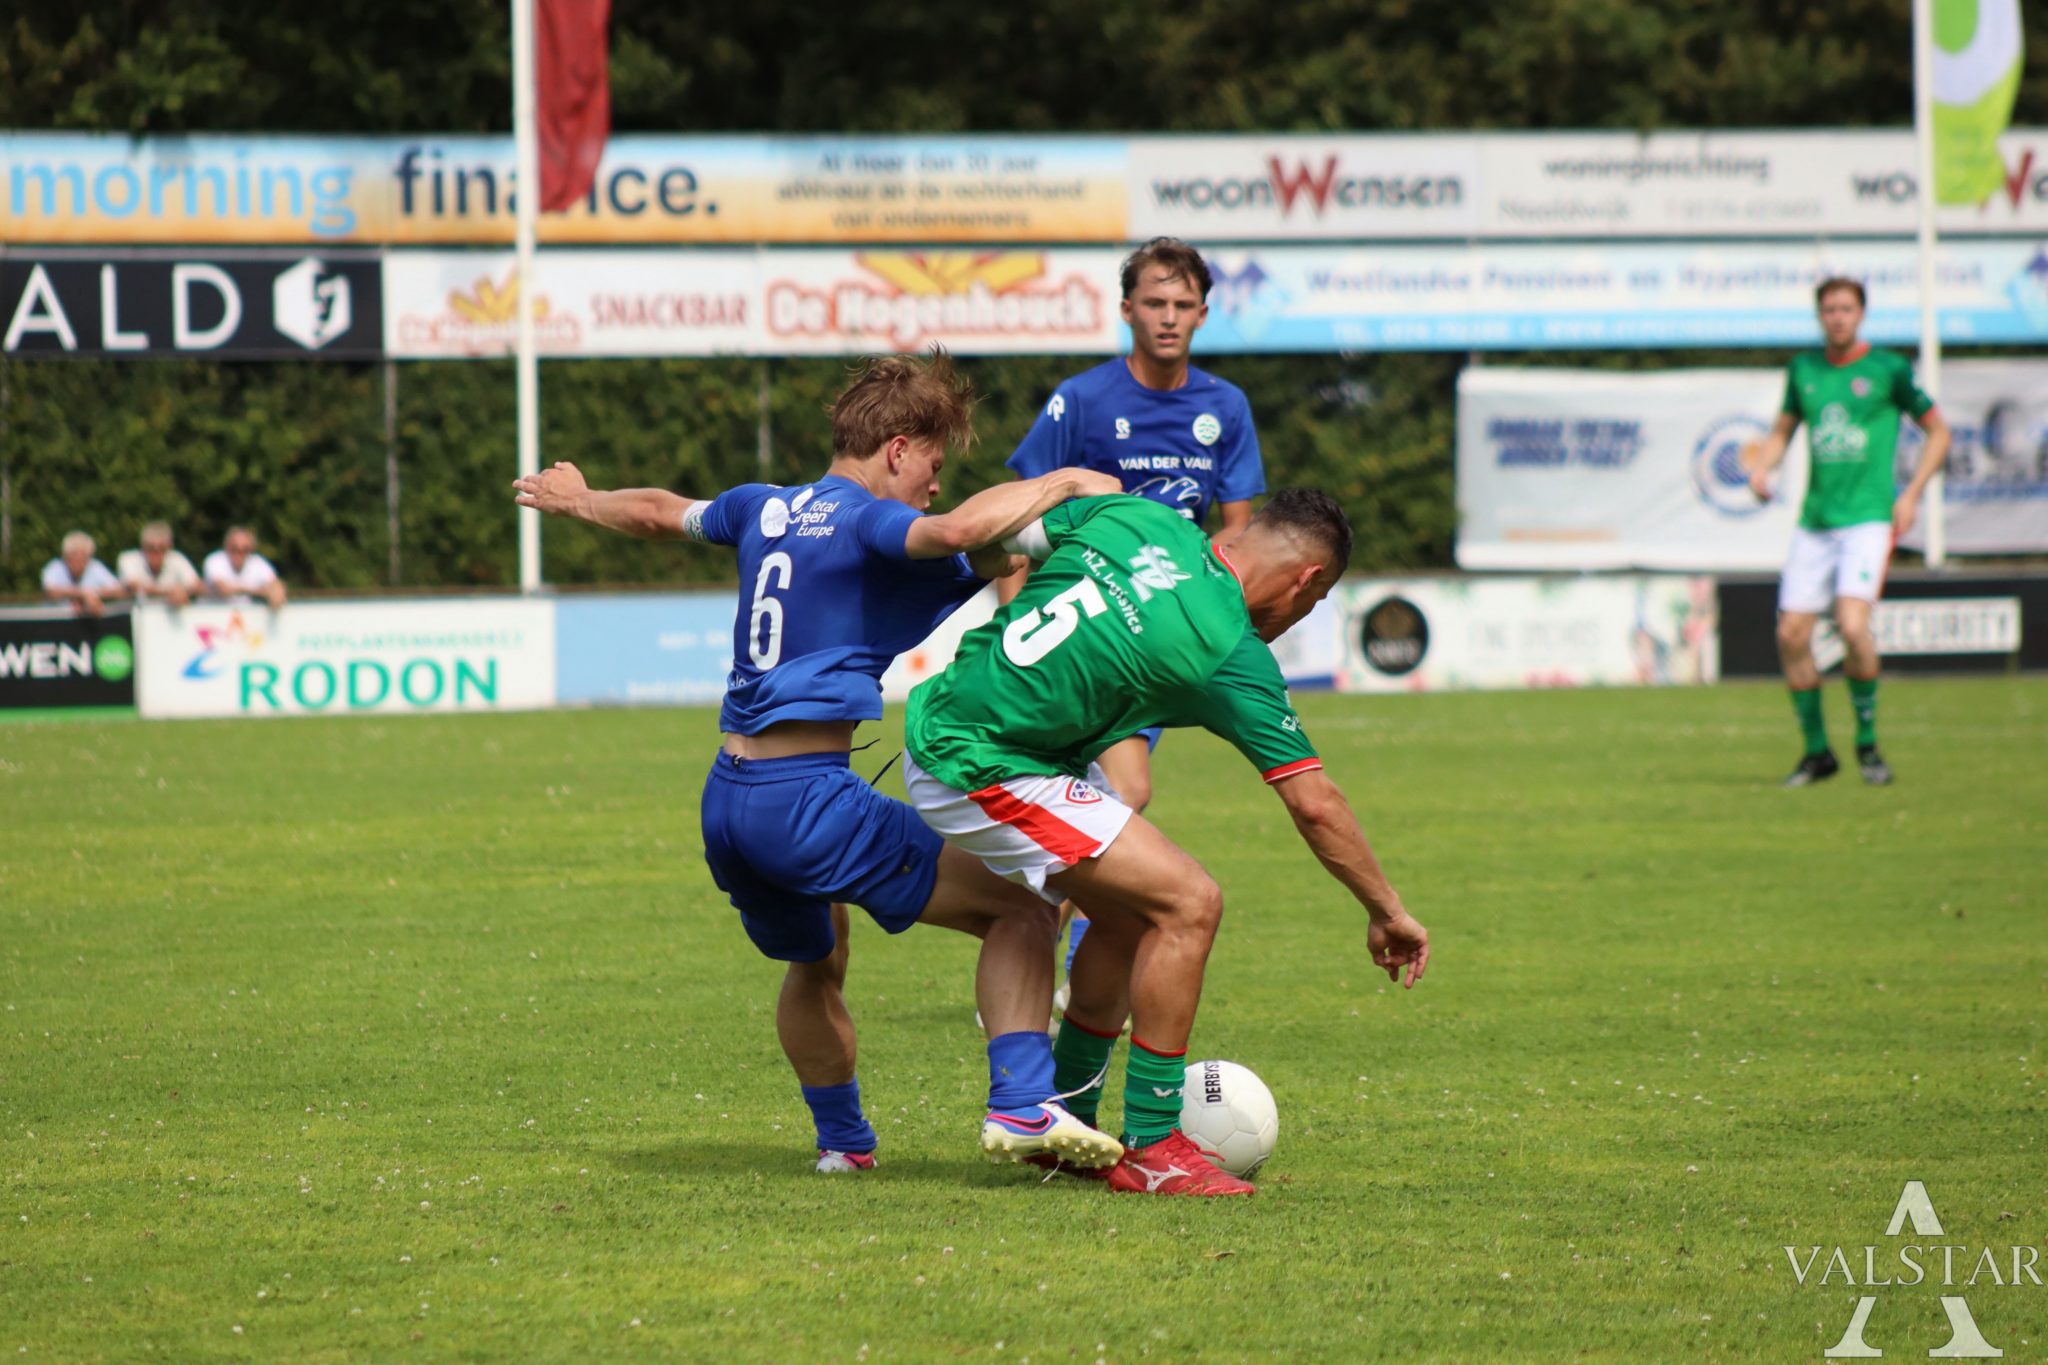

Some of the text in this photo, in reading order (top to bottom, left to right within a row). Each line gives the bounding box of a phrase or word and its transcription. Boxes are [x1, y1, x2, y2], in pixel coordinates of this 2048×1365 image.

[8, 146, 718, 236] morning fince.
[4, 264, 243, 351] ALD
[590, 292, 747, 328] SNACKBAR
[1118, 456, 1150, 471] VAN
[1152, 455, 1181, 470] DER
[808, 500, 840, 513] Total
[796, 523, 835, 540] Europe
[748, 551, 792, 671] 6
[1003, 575, 1109, 668] 5
[0, 642, 92, 679] WEN
[238, 655, 499, 711] RODON
